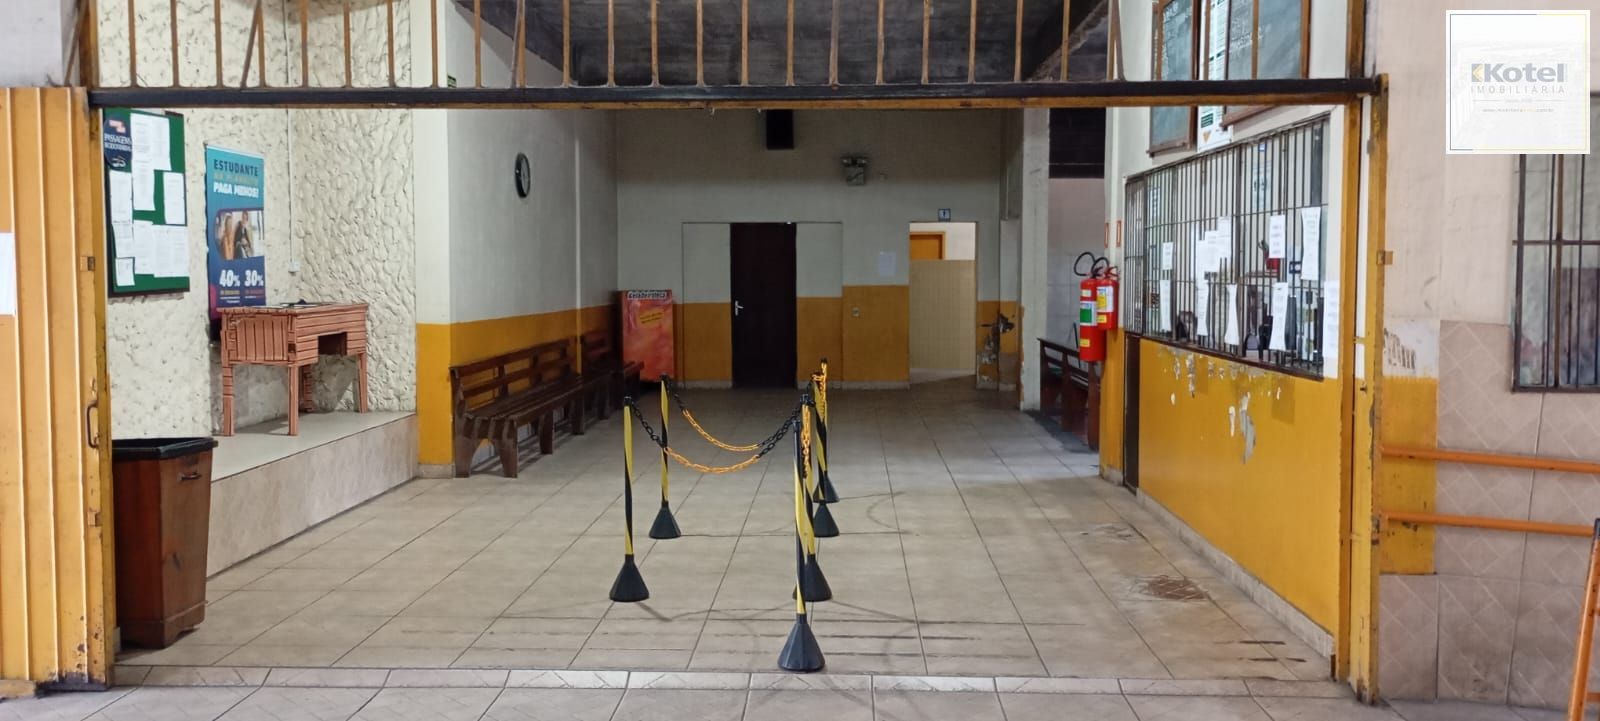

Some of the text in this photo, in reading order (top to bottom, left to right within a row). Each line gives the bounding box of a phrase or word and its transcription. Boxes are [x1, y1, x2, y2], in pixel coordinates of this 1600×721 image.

[213, 159, 258, 176] ESTUDANTE
[213, 181, 232, 194] PAGA
[219, 269, 241, 287] 40%
[244, 269, 264, 287] 30%
